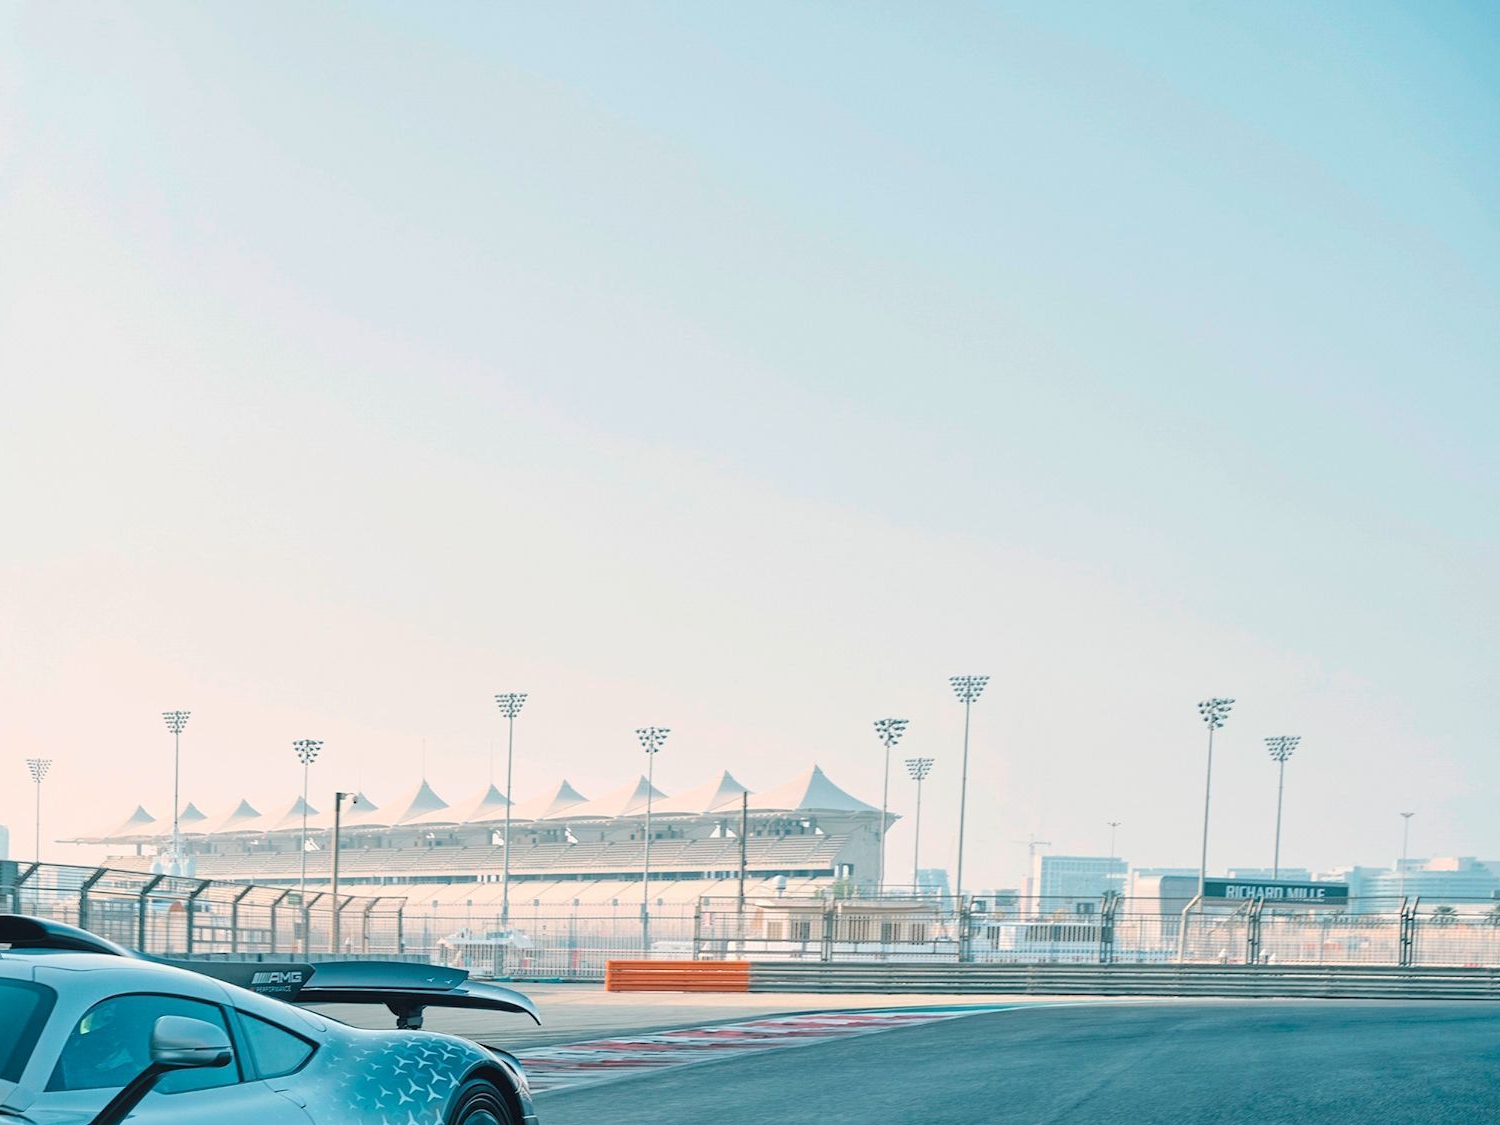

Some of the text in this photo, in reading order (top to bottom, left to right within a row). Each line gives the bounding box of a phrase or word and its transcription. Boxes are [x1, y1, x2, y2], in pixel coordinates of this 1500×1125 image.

[1225, 885, 1326, 902] RICHARD MILLE
[268, 971, 302, 983] AMG
